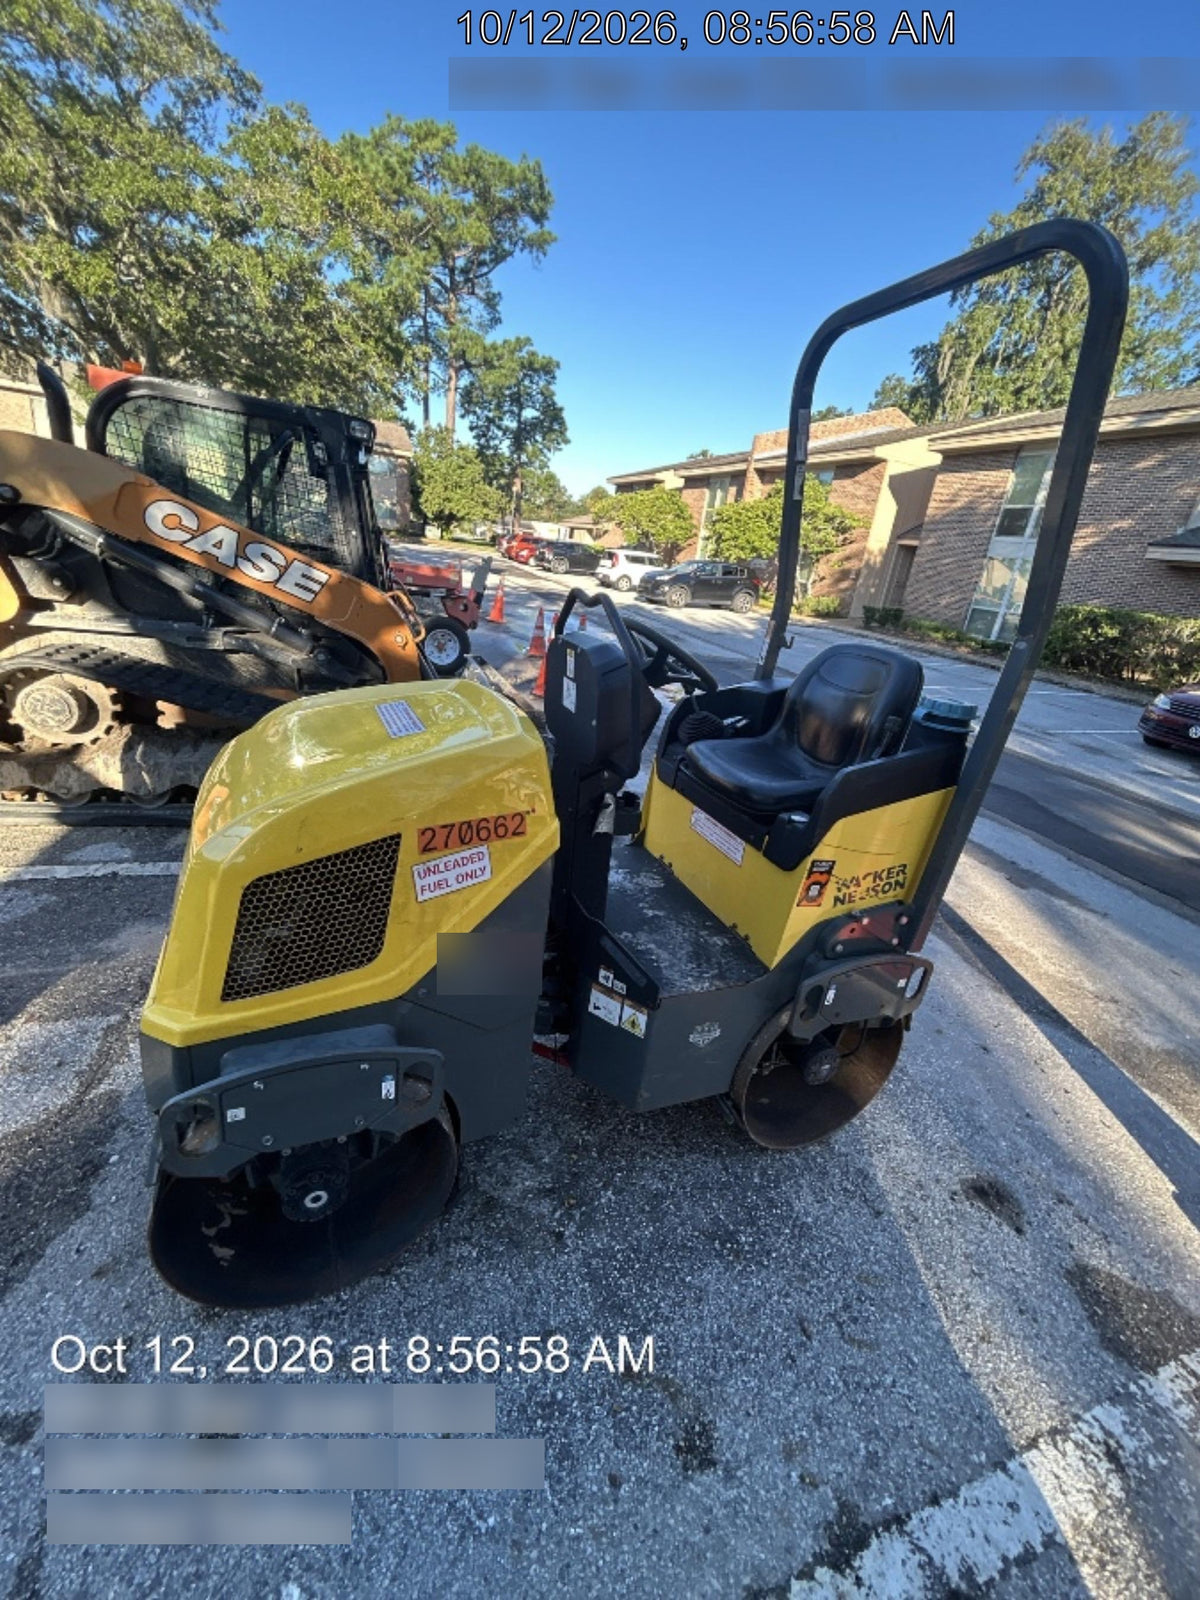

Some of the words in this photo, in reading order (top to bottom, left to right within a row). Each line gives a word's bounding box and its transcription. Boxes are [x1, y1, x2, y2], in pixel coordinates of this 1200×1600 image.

[143, 499, 332, 603] CASE
[420, 812, 527, 853] 270662
[416, 850, 485, 880] UNLEADED
[420, 877, 452, 896] FUEL
[455, 865, 487, 884] ONLY
